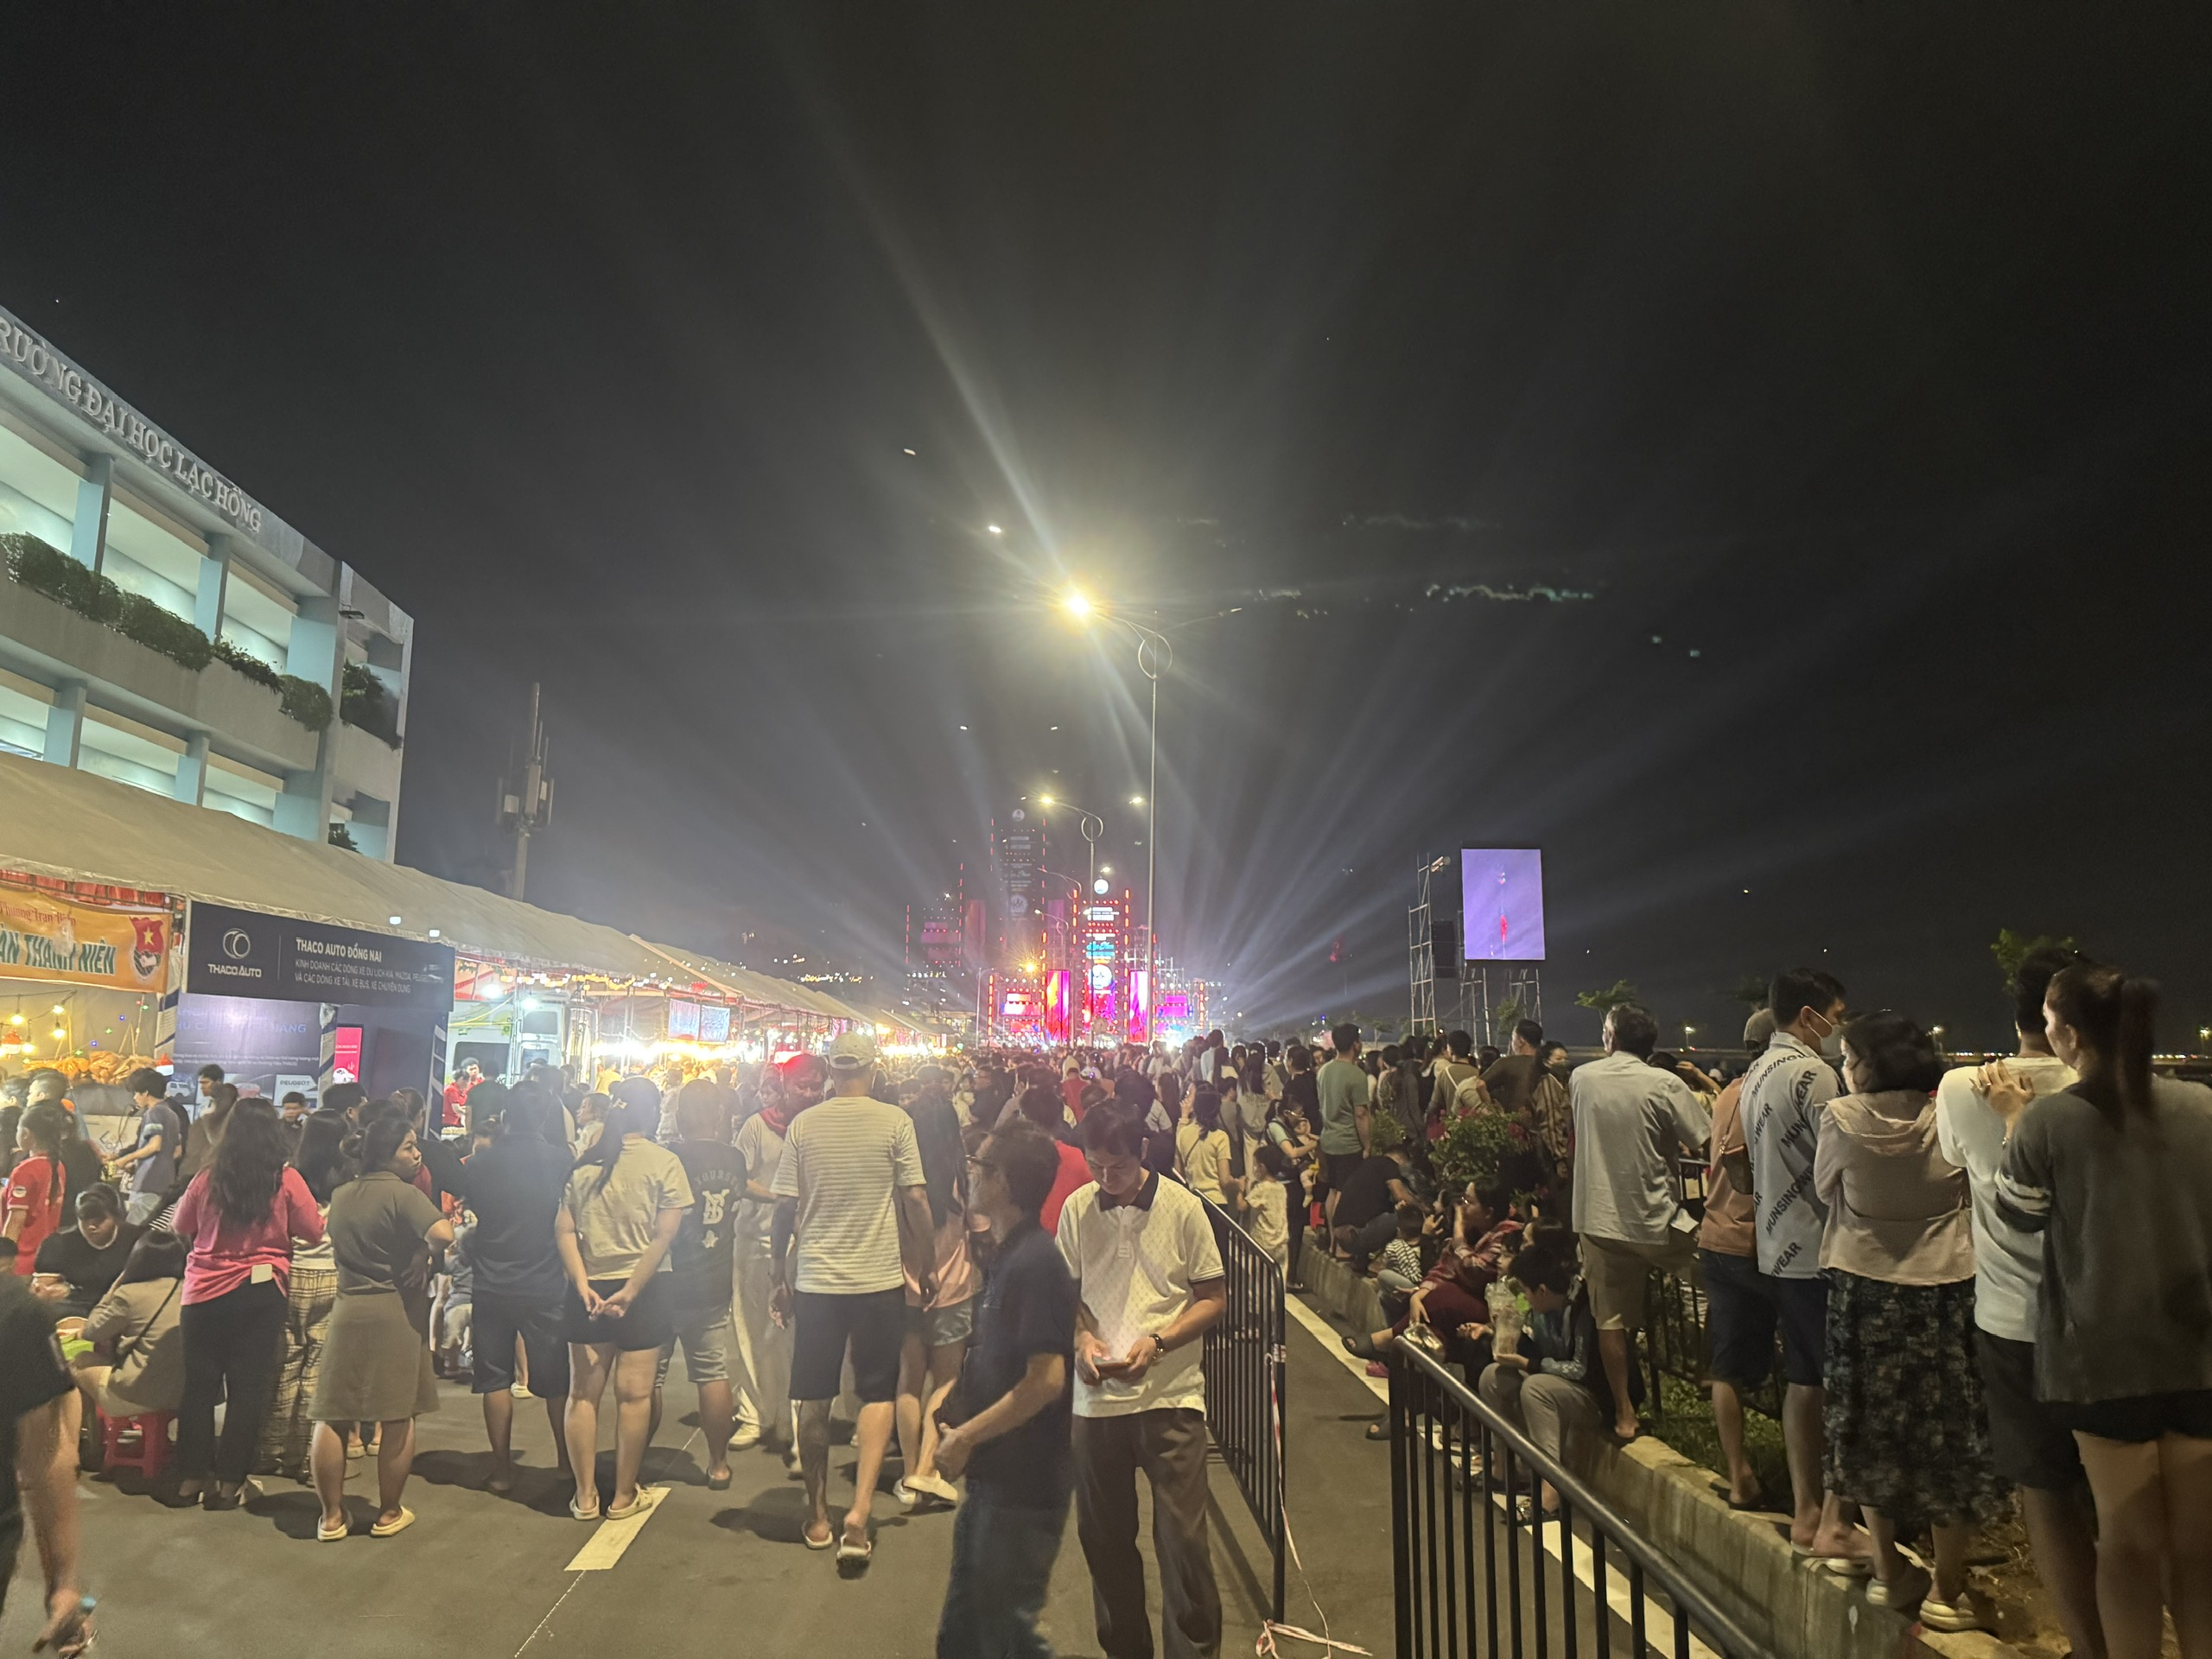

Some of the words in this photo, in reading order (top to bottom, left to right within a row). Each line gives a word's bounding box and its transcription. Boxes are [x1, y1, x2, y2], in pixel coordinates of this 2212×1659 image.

[0, 316, 81, 404] RƯỜNG
[82, 383, 129, 437] ĐẠI
[127, 416, 173, 467] HỌC
[174, 450, 213, 499] LẠC
[213, 480, 262, 533] HỒNG
[0, 923, 19, 964] ÀN
[79, 938, 117, 975] NIÊN
[296, 938, 323, 954] THACO
[325, 943, 346, 957] AUTO
[369, 950, 382, 963] NAI
[207, 963, 238, 976] THACO
[238, 966, 262, 978] AUTO
[296, 959, 309, 969] KINH
[310, 960, 329, 970] DOANH
[1771, 1242, 1802, 1277] WEAR
